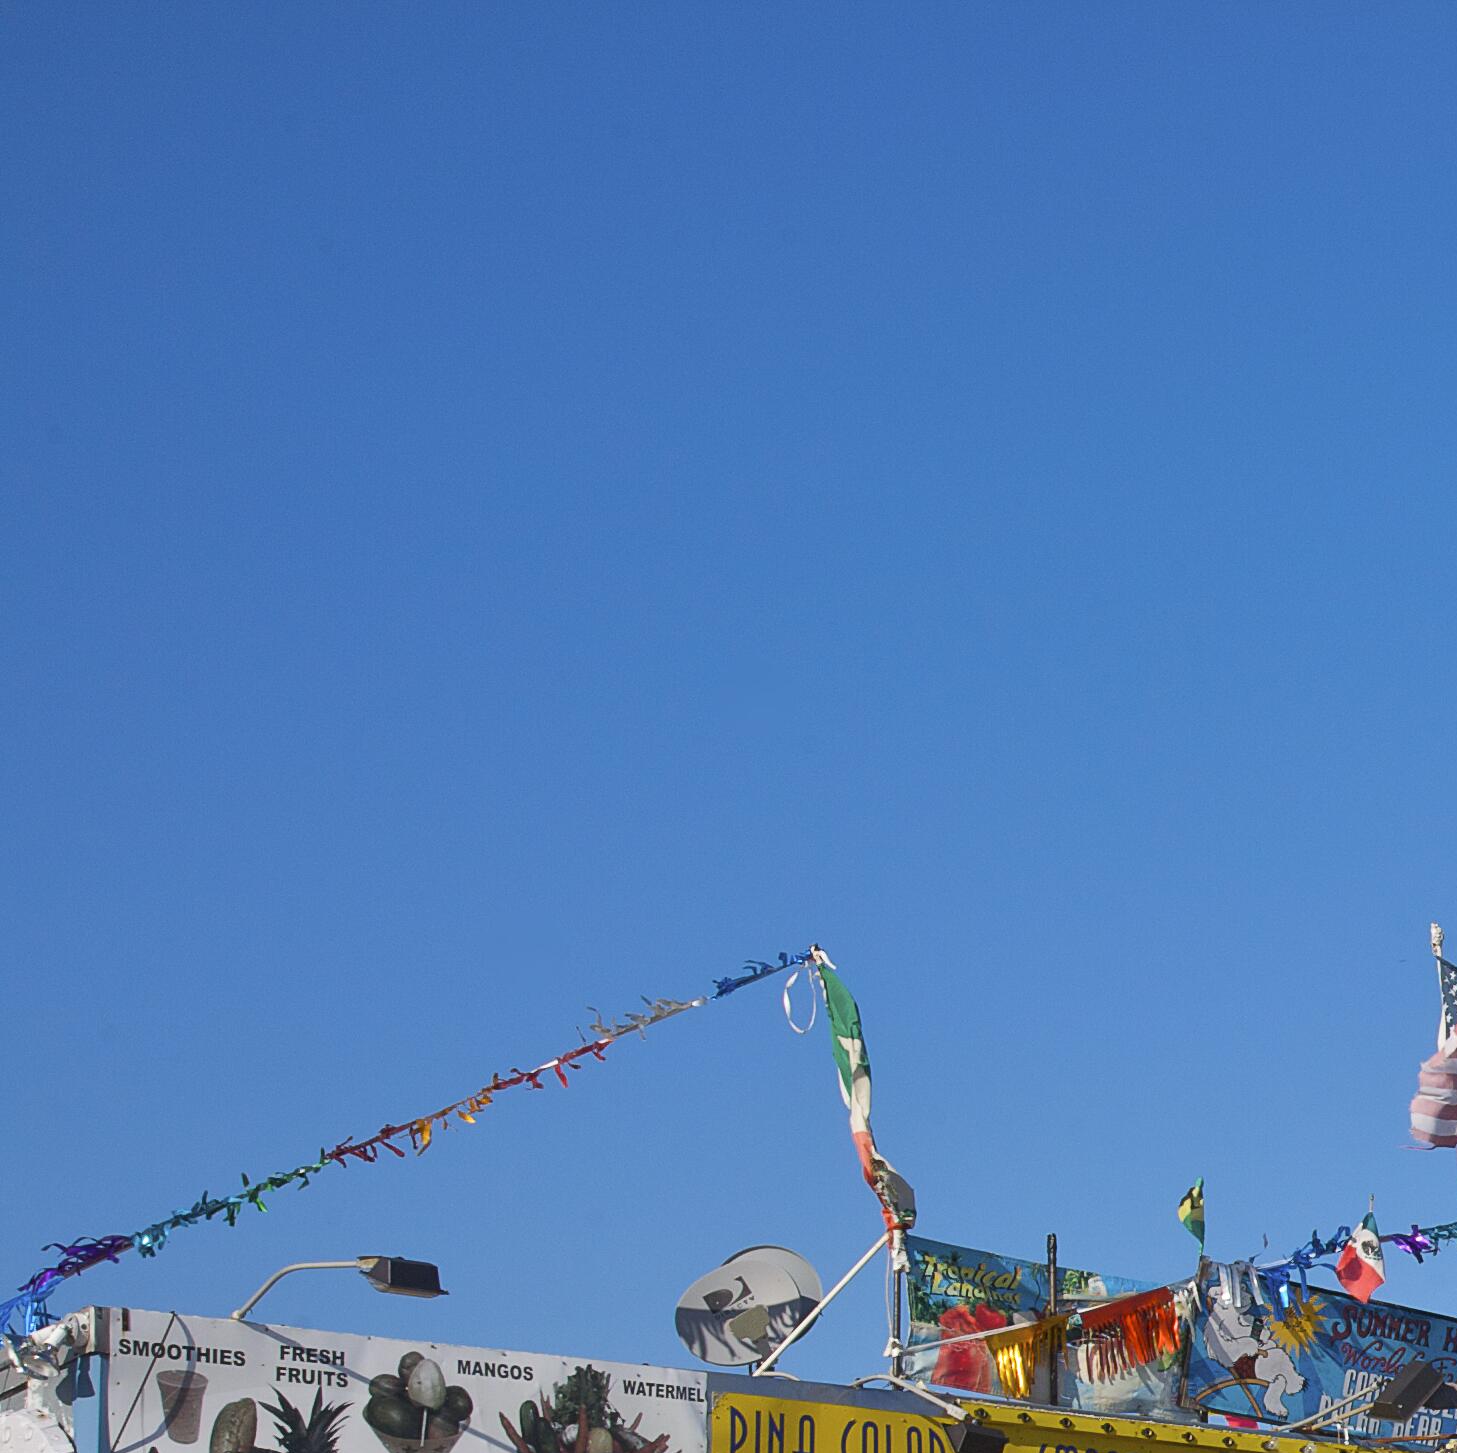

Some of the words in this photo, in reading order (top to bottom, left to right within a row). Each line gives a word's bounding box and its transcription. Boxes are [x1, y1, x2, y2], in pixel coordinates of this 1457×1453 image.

[1330, 1304, 1431, 1347] SUMMER
[118, 1338, 246, 1368] SMOOTHIES
[279, 1344, 346, 1366] FRESH
[275, 1366, 349, 1388] FRUITS
[456, 1359, 535, 1382] MANGOS
[622, 1378, 706, 1402] WATERMEL
